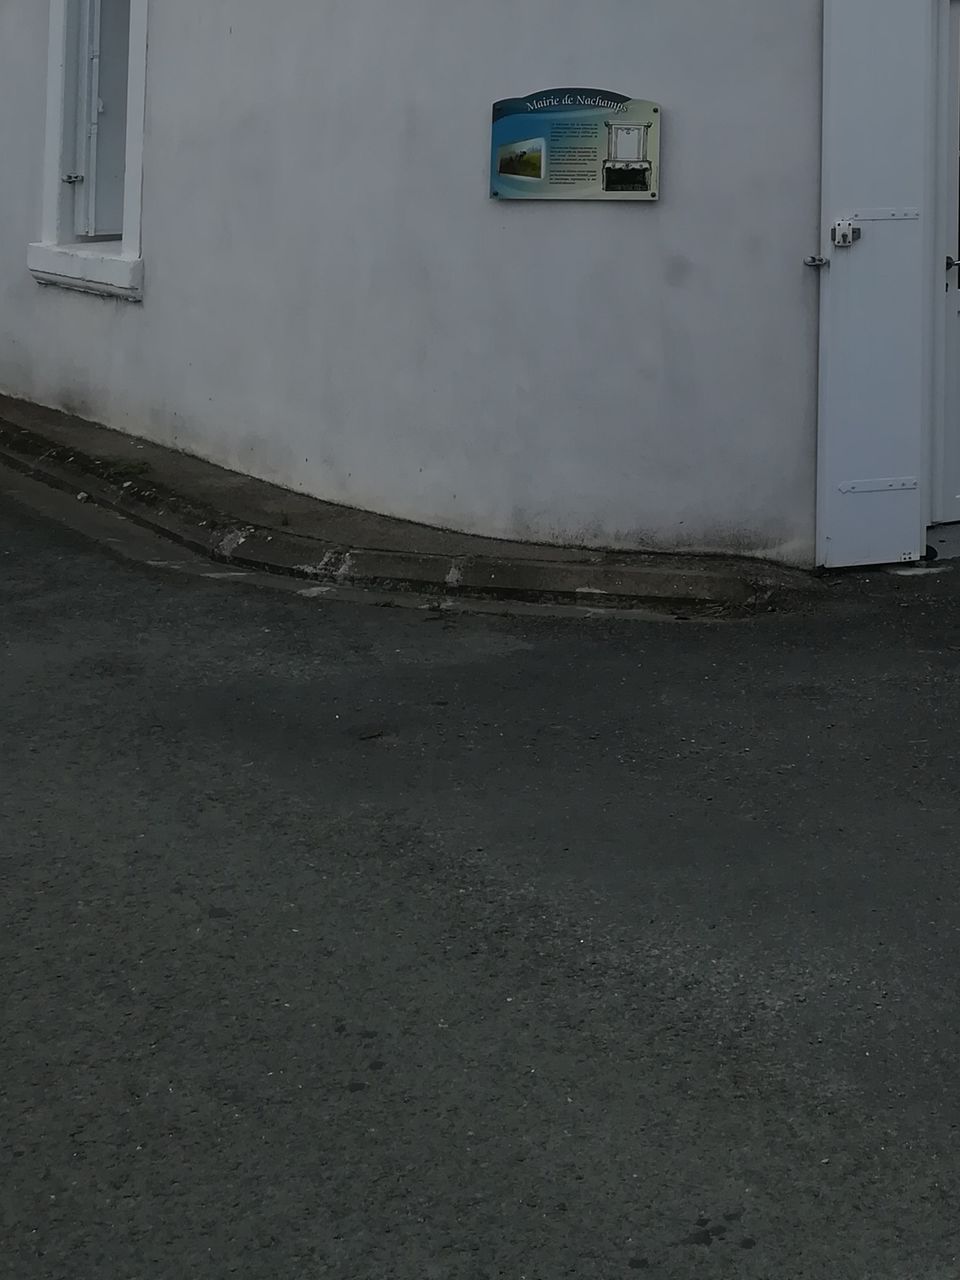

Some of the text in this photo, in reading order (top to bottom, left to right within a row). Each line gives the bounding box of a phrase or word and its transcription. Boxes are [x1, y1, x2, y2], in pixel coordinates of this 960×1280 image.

[526, 93, 628, 113] Mairie de Nachamps
